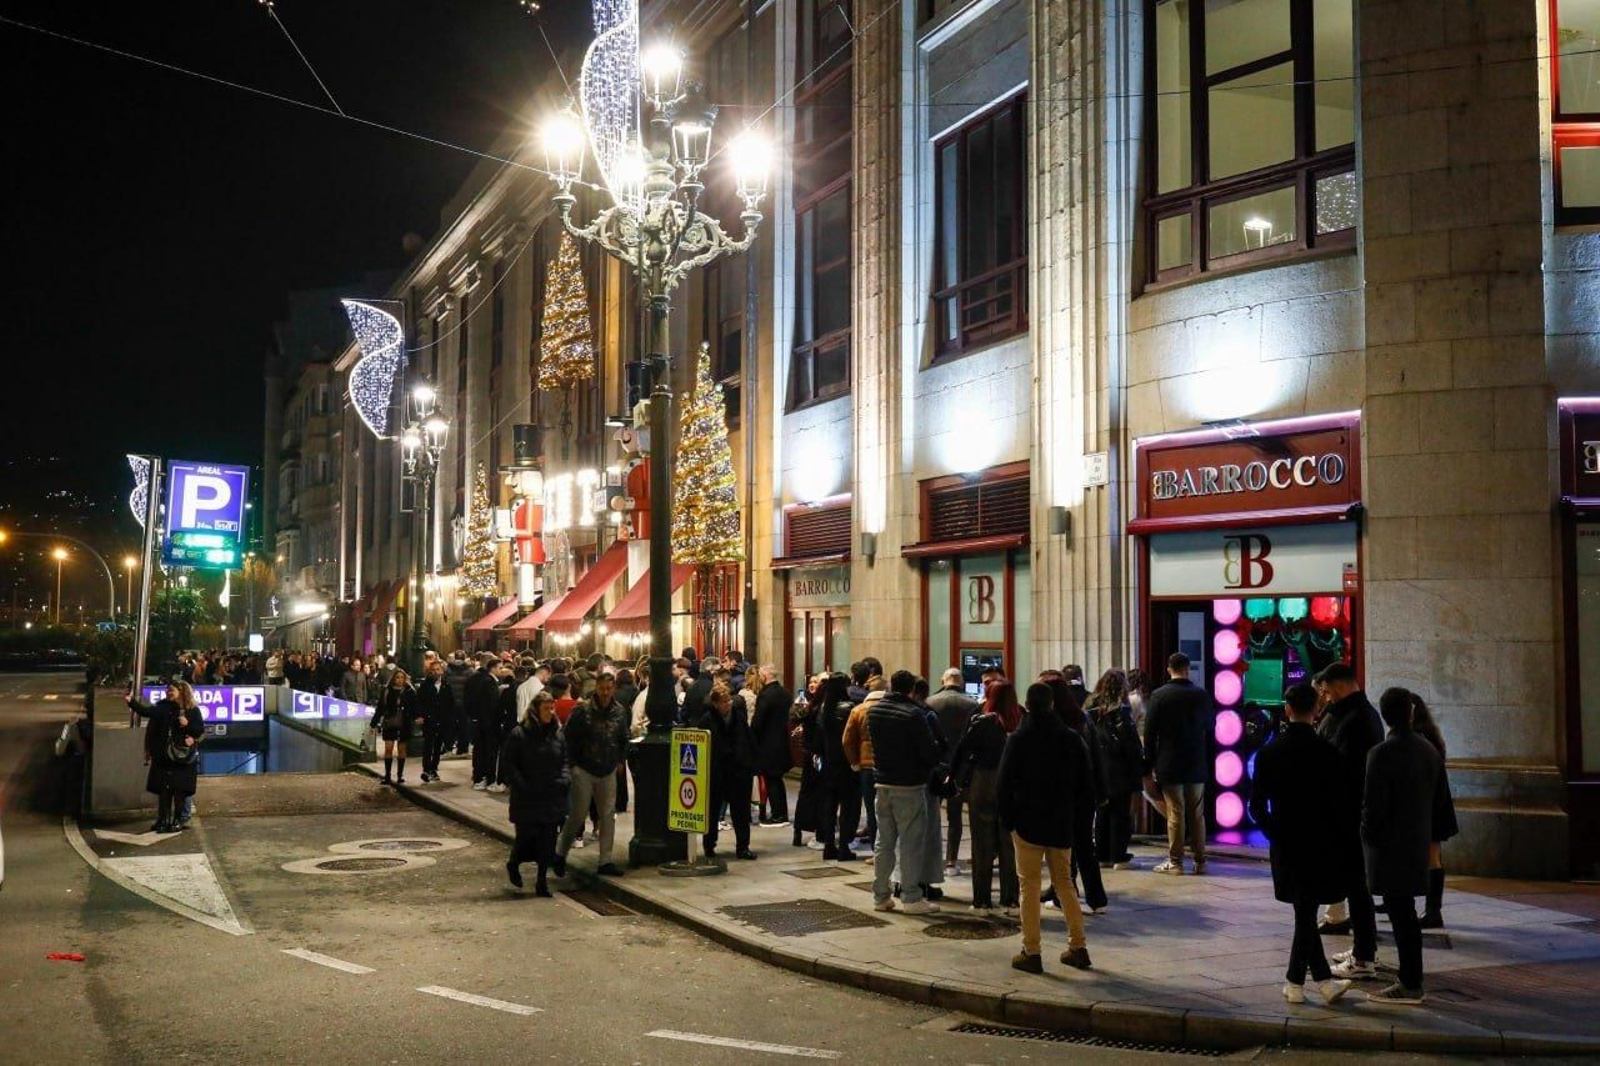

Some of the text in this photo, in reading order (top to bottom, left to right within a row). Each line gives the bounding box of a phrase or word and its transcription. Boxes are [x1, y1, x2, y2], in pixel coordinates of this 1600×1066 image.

[197, 466, 221, 475] AREAL
[1153, 454, 1345, 499] BARROCCO
[181, 475, 231, 528] P
[795, 581, 851, 597] BARROCCO
[238, 694, 257, 714] P
[683, 787, 693, 798] 10
